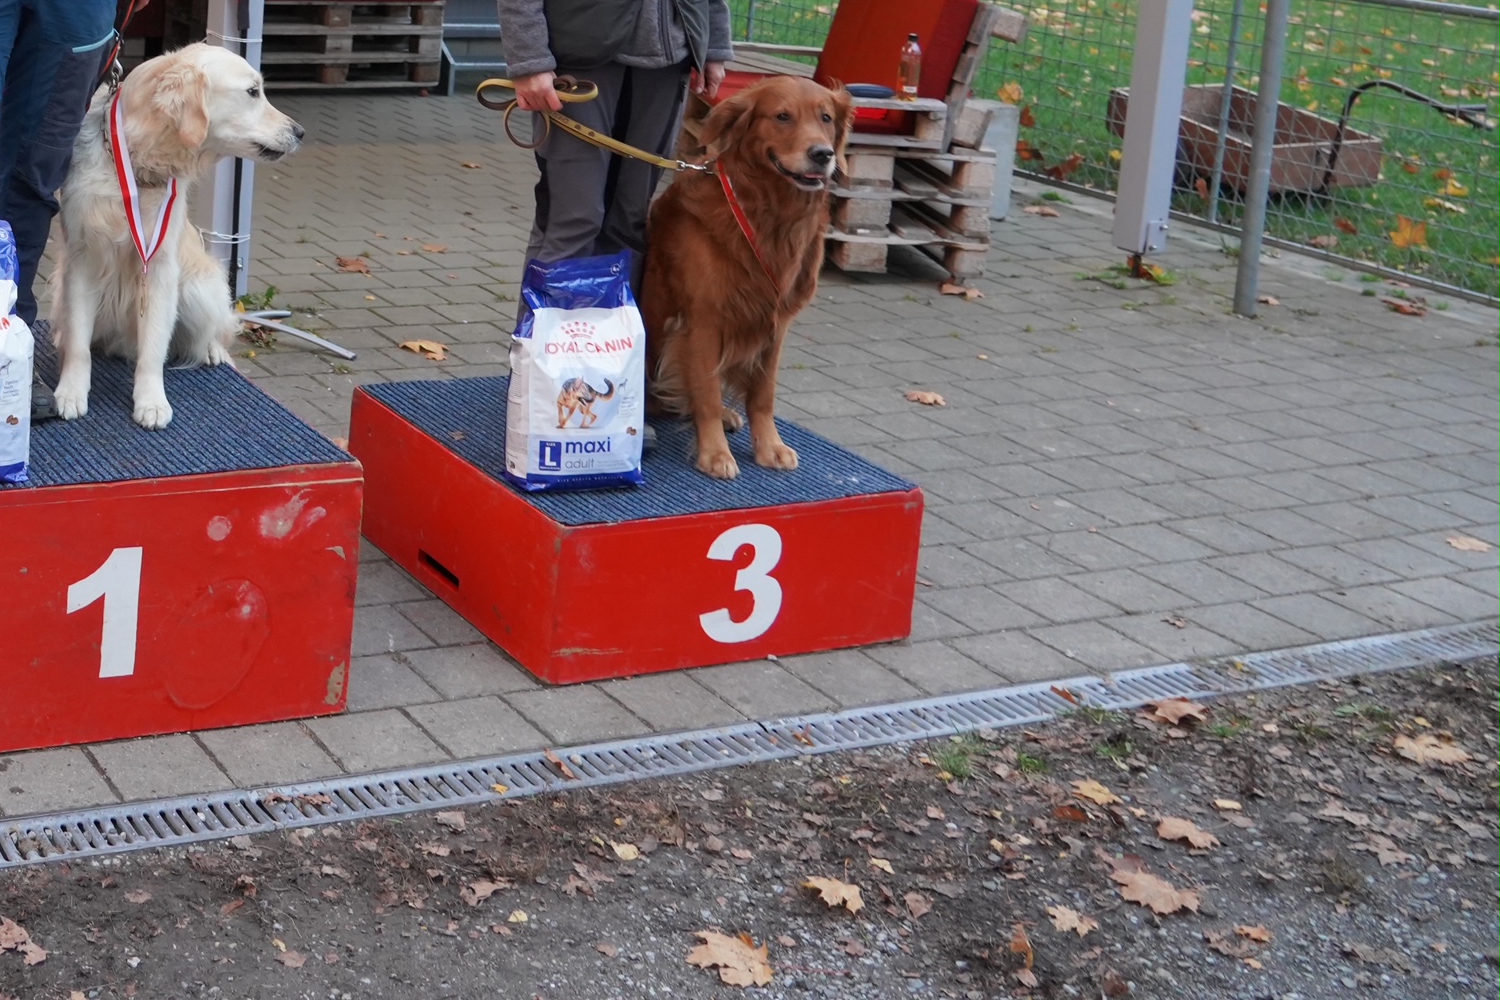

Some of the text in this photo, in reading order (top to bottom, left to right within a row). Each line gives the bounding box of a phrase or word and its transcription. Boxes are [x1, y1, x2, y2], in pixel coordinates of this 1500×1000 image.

[585, 337, 633, 353] CANIN
[565, 436, 610, 453] maxi
[545, 446, 557, 466] L
[565, 459, 595, 469] adult
[699, 524, 783, 643] 3
[67, 547, 143, 678] 1
